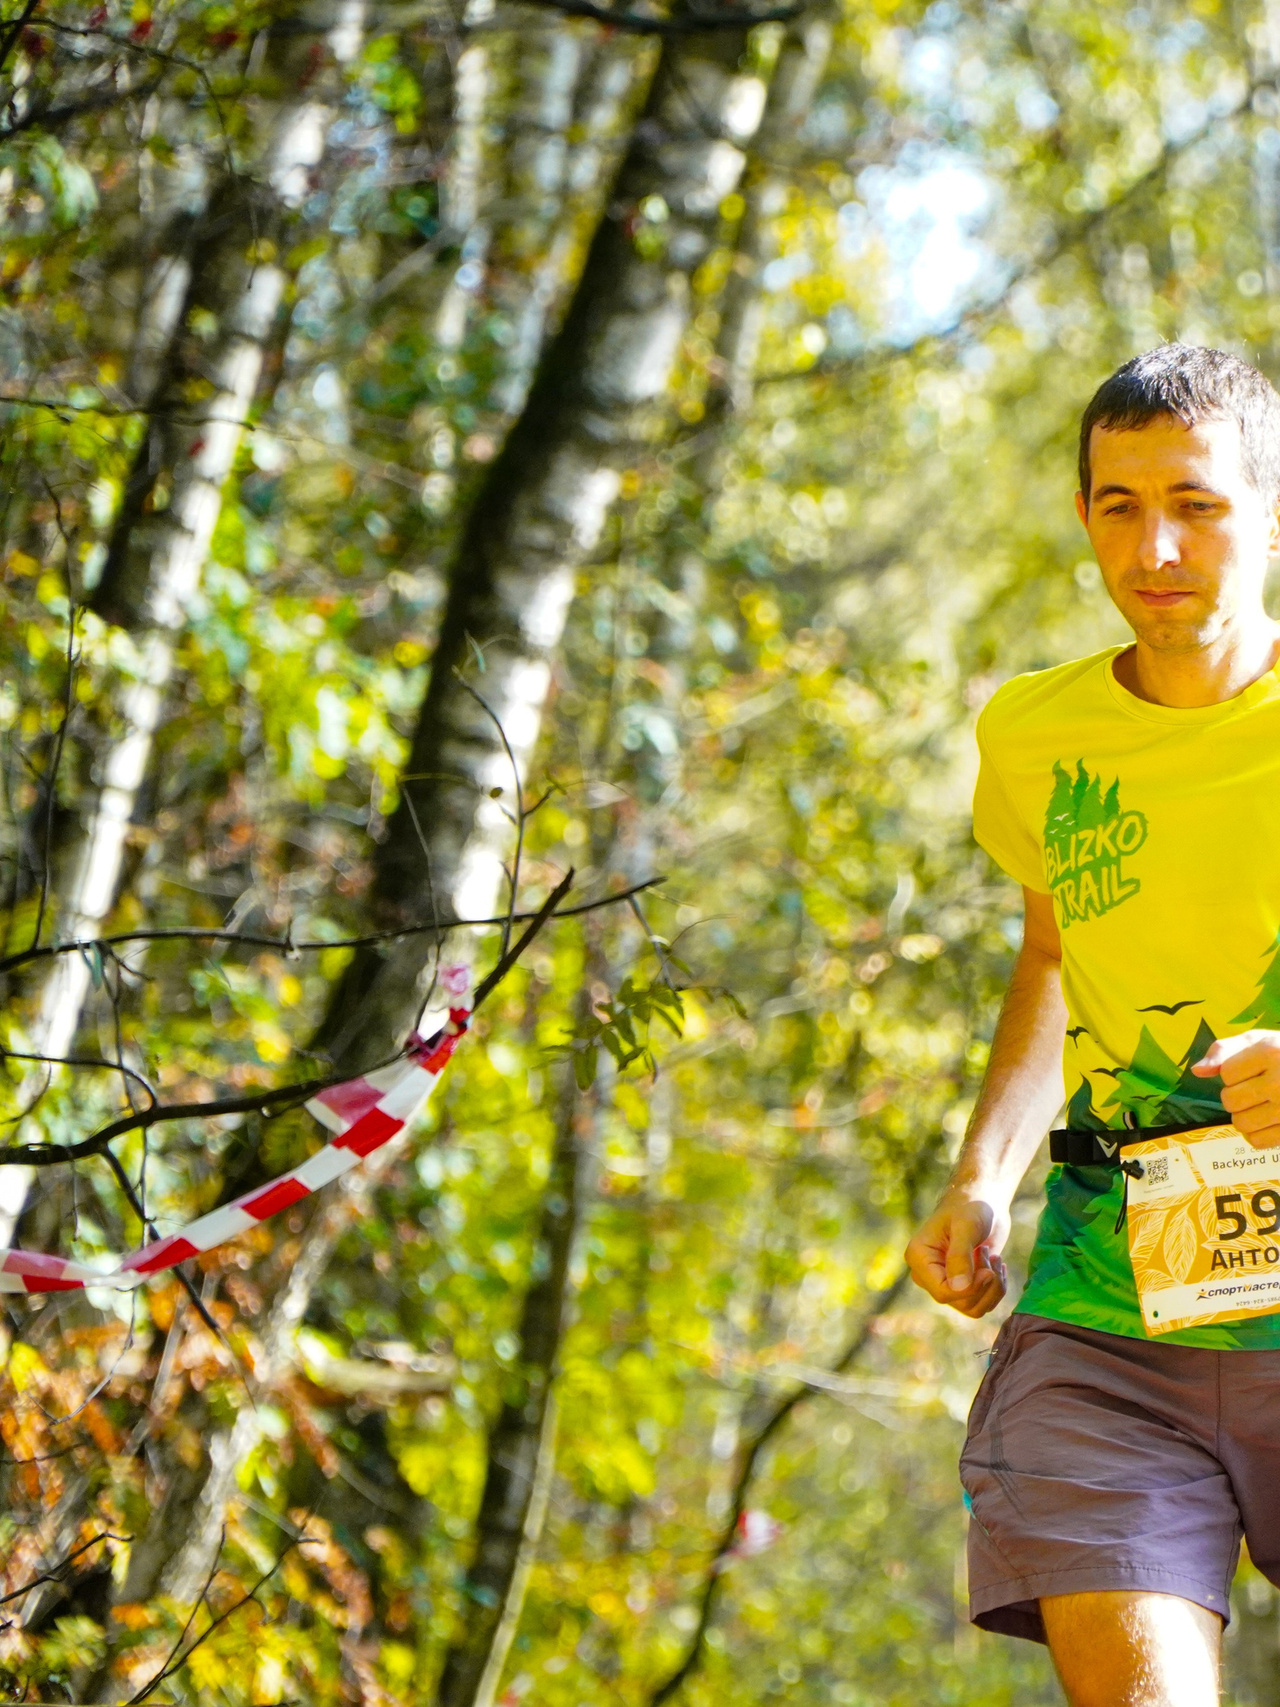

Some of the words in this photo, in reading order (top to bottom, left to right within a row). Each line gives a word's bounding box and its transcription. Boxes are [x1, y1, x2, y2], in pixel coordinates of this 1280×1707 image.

[1045, 813, 1145, 884] BLIZKO
[1052, 863, 1138, 926] TRAIL
[1212, 1155, 1266, 1170] Backyard
[1235, 1147, 1245, 1155] 28
